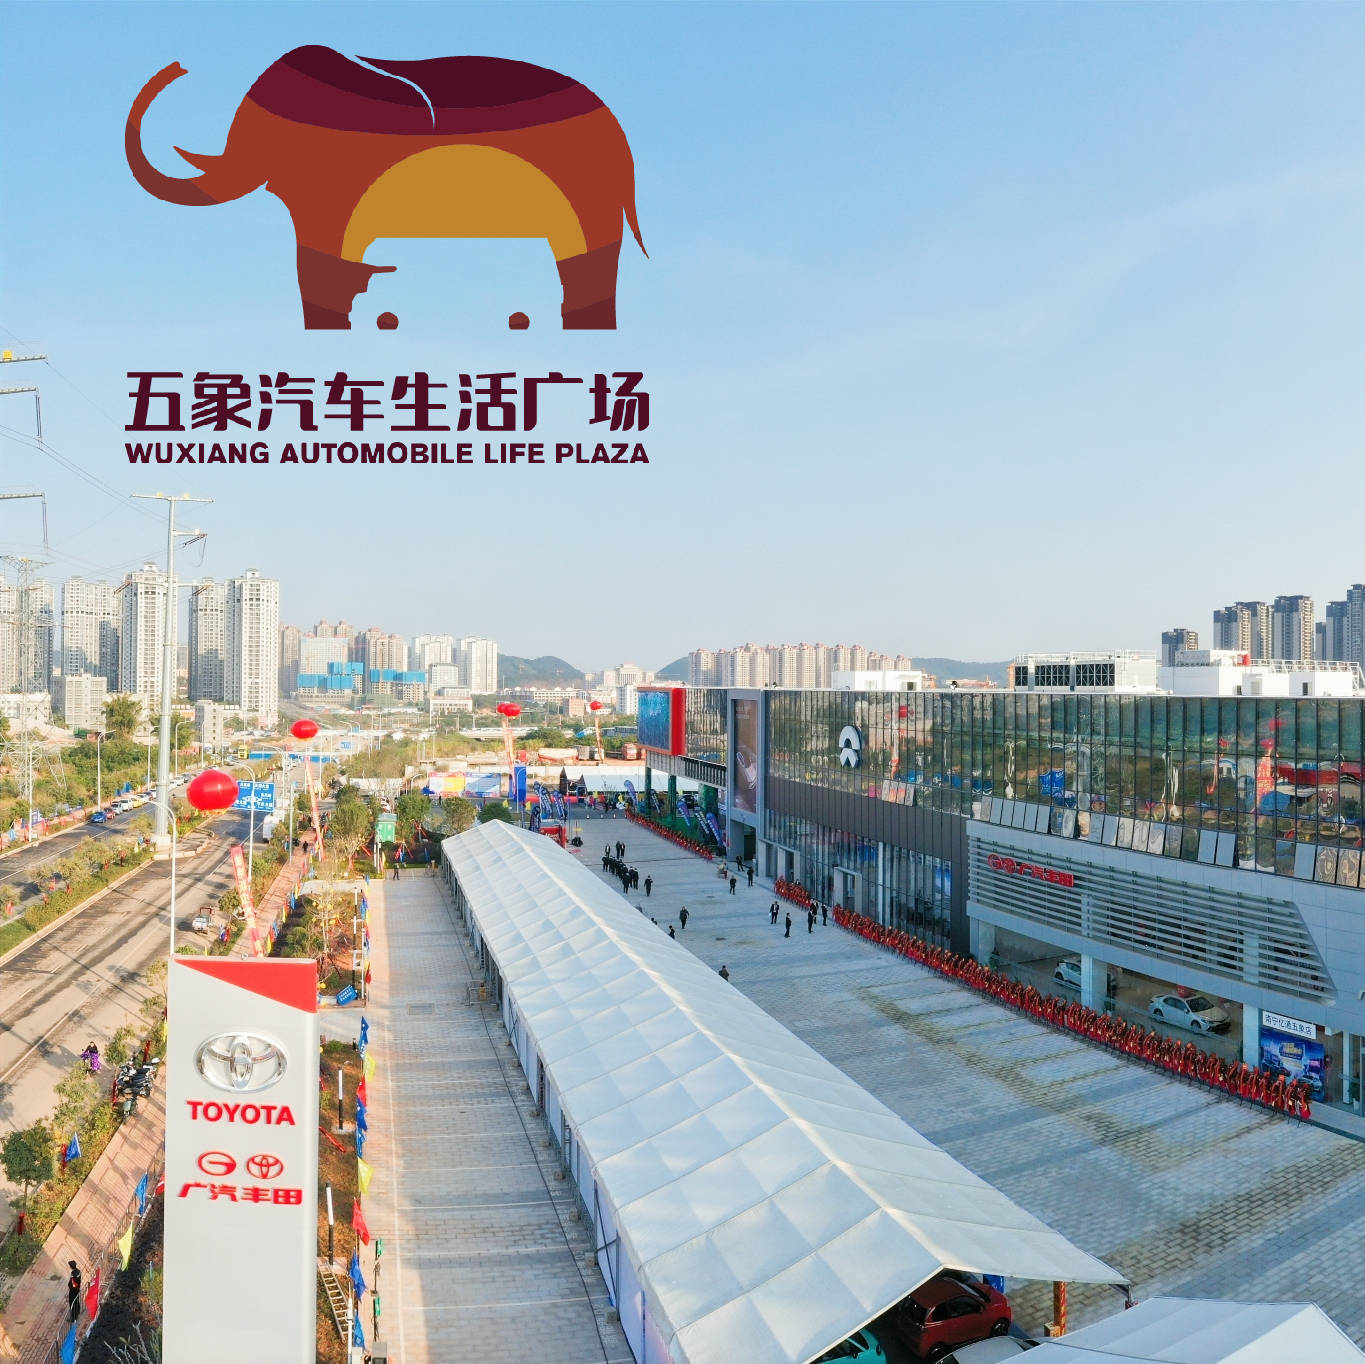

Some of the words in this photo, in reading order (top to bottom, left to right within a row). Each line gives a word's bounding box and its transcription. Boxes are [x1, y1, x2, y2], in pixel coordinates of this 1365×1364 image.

[186, 1100, 296, 1126] TOYOTA
[177, 1181, 303, 1206] 广汽丰田
